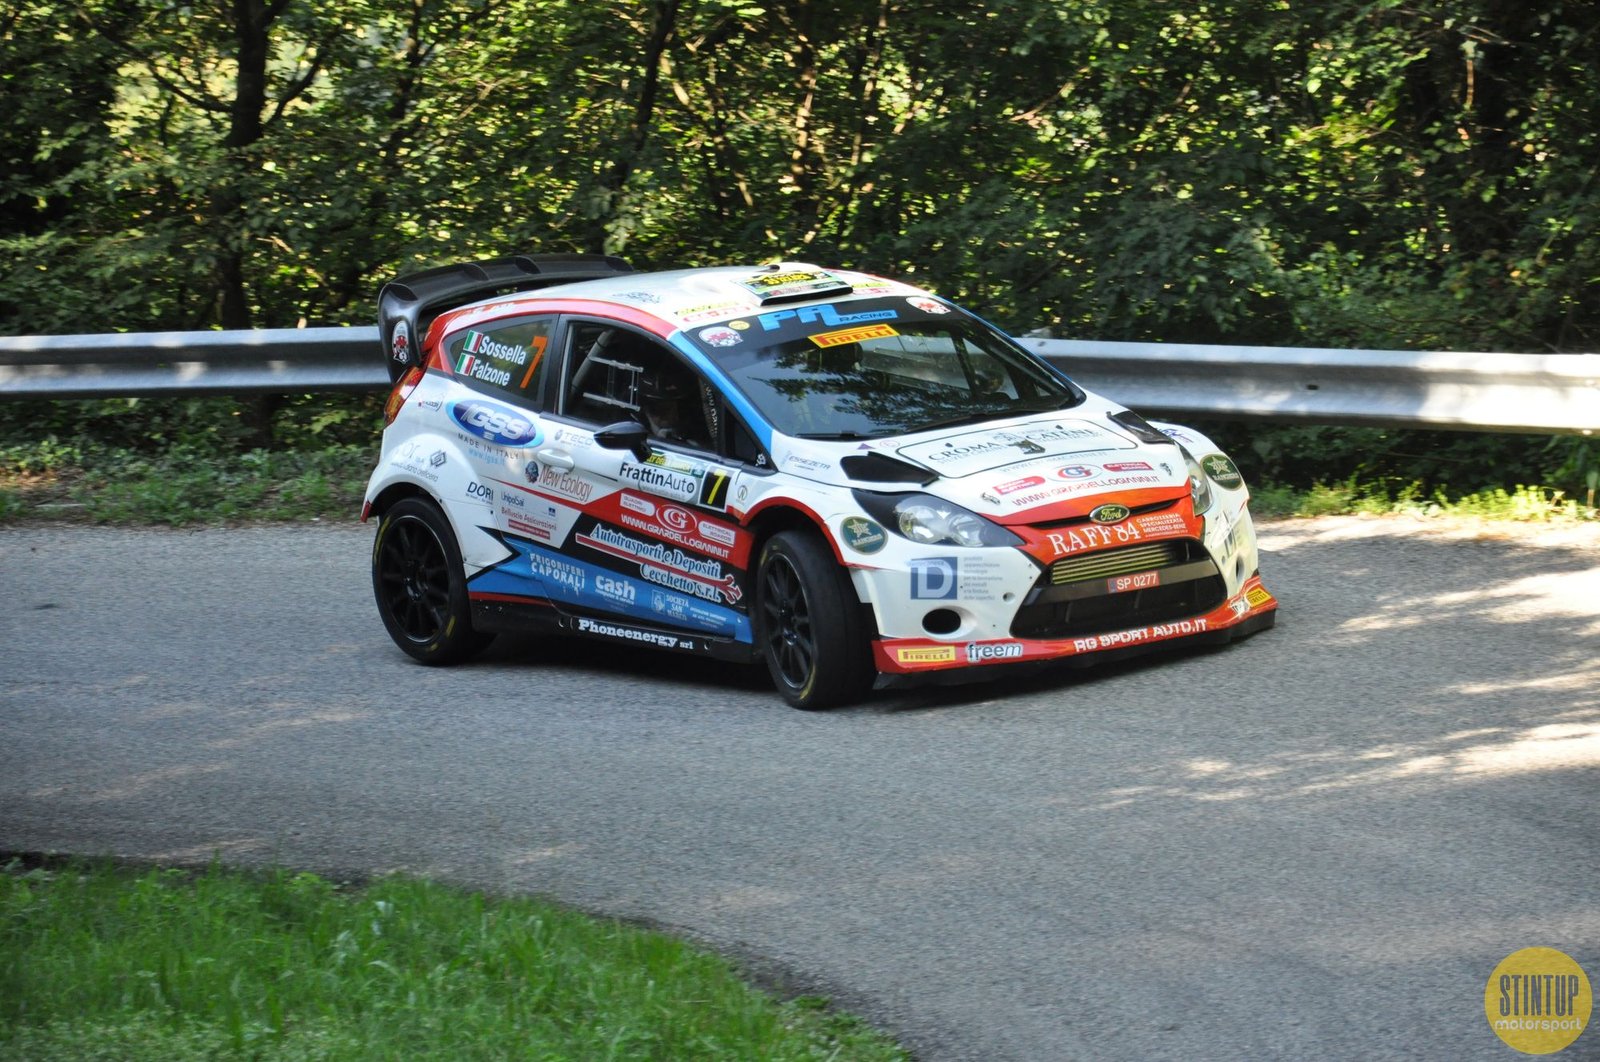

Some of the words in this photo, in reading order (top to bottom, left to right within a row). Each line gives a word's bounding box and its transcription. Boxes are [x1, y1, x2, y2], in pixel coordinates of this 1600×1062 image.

[839, 310, 894, 323] RACING
[818, 325, 894, 348] PIRELLI
[479, 335, 526, 365] Sossella
[520, 335, 548, 389] 7
[470, 359, 511, 387] Falzone
[458, 433, 480, 448] MADE
[484, 443, 492, 453] IN
[496, 446, 521, 460] ITALY
[467, 481, 494, 500] DORI
[539, 465, 560, 486] New
[559, 471, 594, 501] Ecology
[619, 462, 695, 494] FrattinAuto
[708, 469, 728, 505] 7
[1100, 508, 1122, 521] Ford
[1136, 512, 1180, 523] CARROZZERIA
[1140, 518, 1184, 528] SPECIALIZZATA
[1046, 525, 1112, 556] RAFF
[1143, 523, 1187, 534] MERCEDES-BENZ
[591, 523, 664, 560] Autotrasporti
[673, 550, 719, 578] Depositi
[530, 553, 585, 577] FRIGORIFERI
[531, 563, 585, 589] CAPORALI
[641, 564, 694, 592] Cecchetto
[595, 575, 636, 600] cash
[1116, 578, 1131, 591] SP
[1133, 573, 1157, 588] 0277
[578, 619, 678, 648] Phoneenergy
[679, 641, 694, 650] srl
[1073, 638, 1097, 652] RG
[1099, 627, 1148, 648] SPORT
[1151, 618, 1208, 637] AUTO.IT
[903, 648, 951, 661] PIRELLI
[967, 643, 1021, 660] freem
